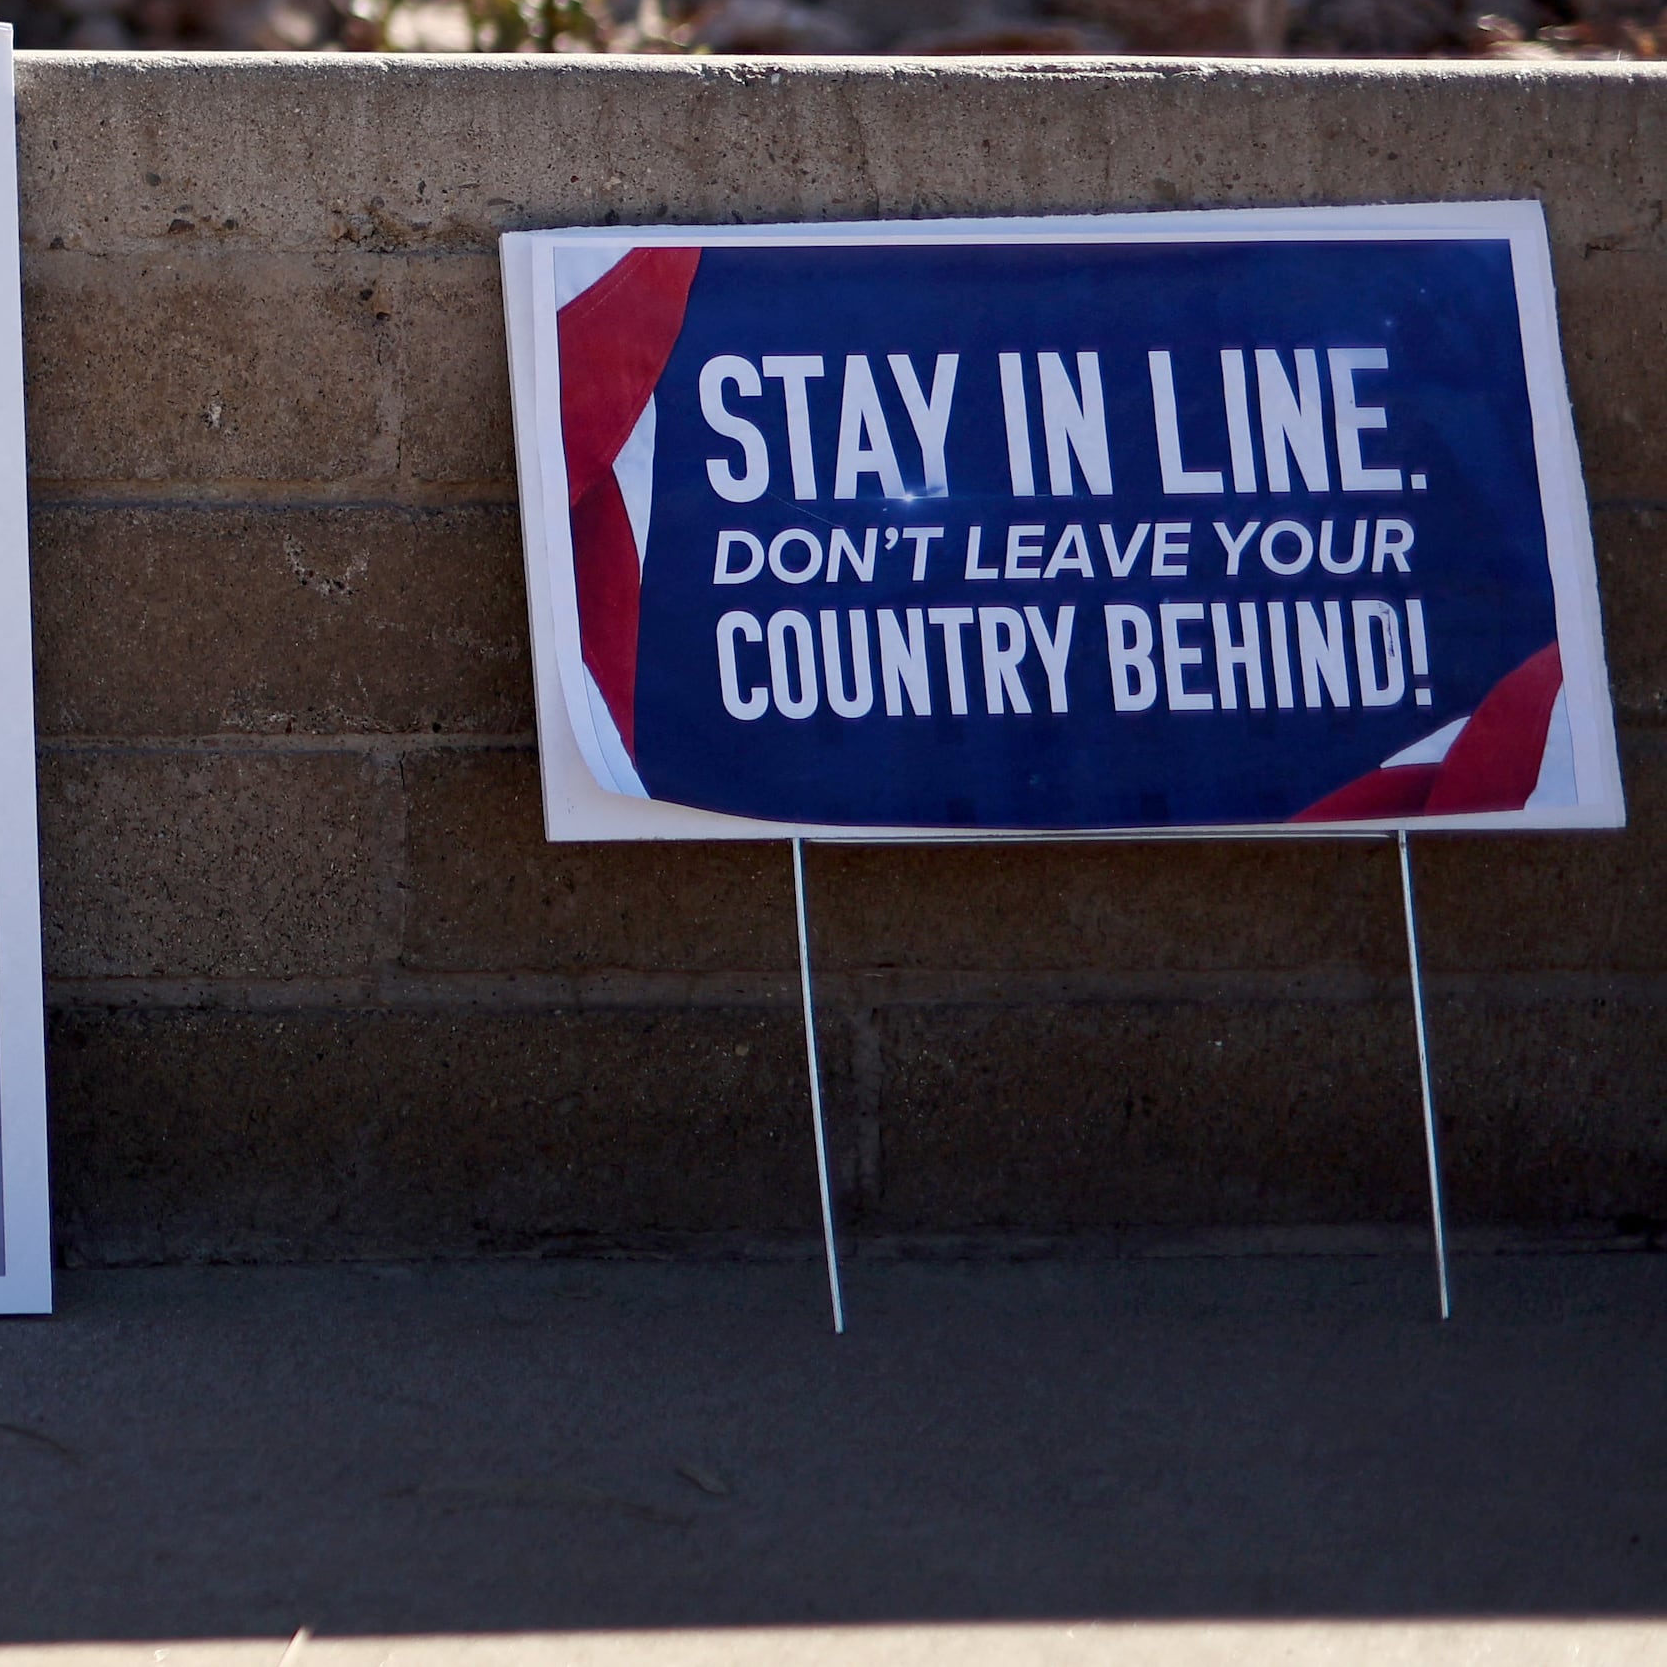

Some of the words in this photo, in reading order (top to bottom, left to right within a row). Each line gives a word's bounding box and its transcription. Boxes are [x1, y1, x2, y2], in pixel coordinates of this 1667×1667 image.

[698, 352, 960, 504] STAY
[998, 351, 1113, 497] IN
[1148, 347, 1428, 495] LINE.
[712, 525, 944, 586] DON’T
[963, 522, 1191, 580] LEAVE
[1213, 518, 1415, 576] YOUR
[716, 604, 1076, 722] COUNTRY
[1104, 598, 1433, 712] BEHIND!
